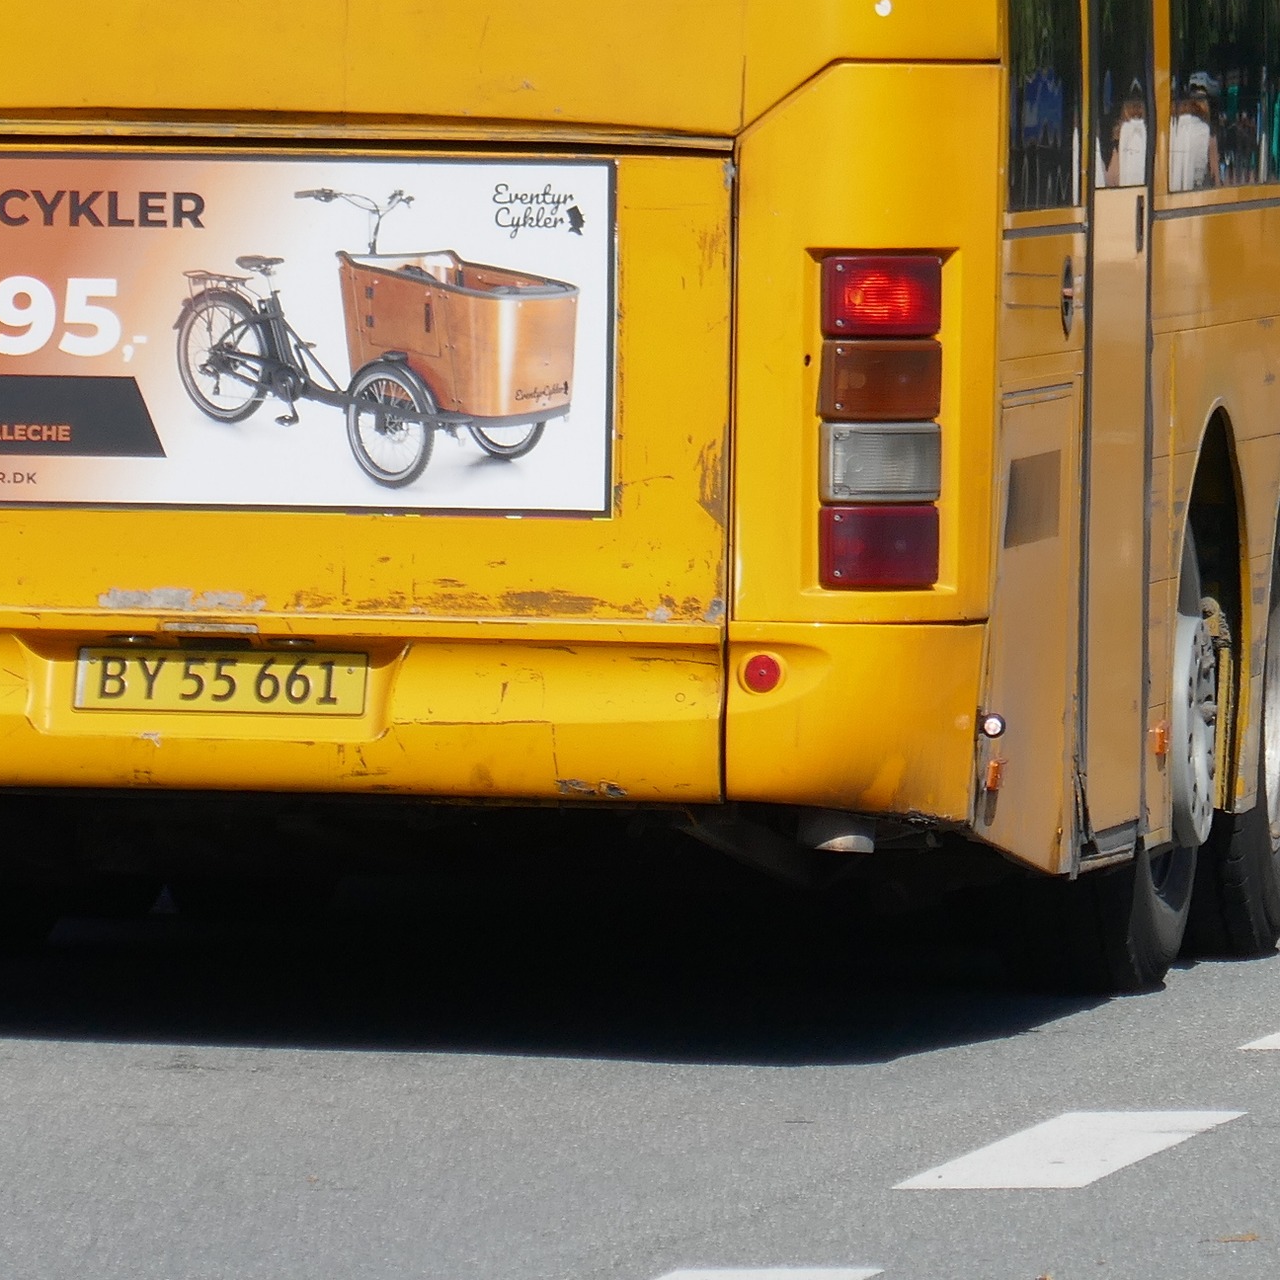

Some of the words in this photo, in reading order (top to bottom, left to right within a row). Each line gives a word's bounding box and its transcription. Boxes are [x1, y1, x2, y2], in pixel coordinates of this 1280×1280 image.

[492, 183, 575, 216] Eventyr
[494, 206, 565, 239] Cykler
[98, 655, 167, 701] BY
[179, 657, 239, 702] 55
[253, 657, 339, 706] 661
